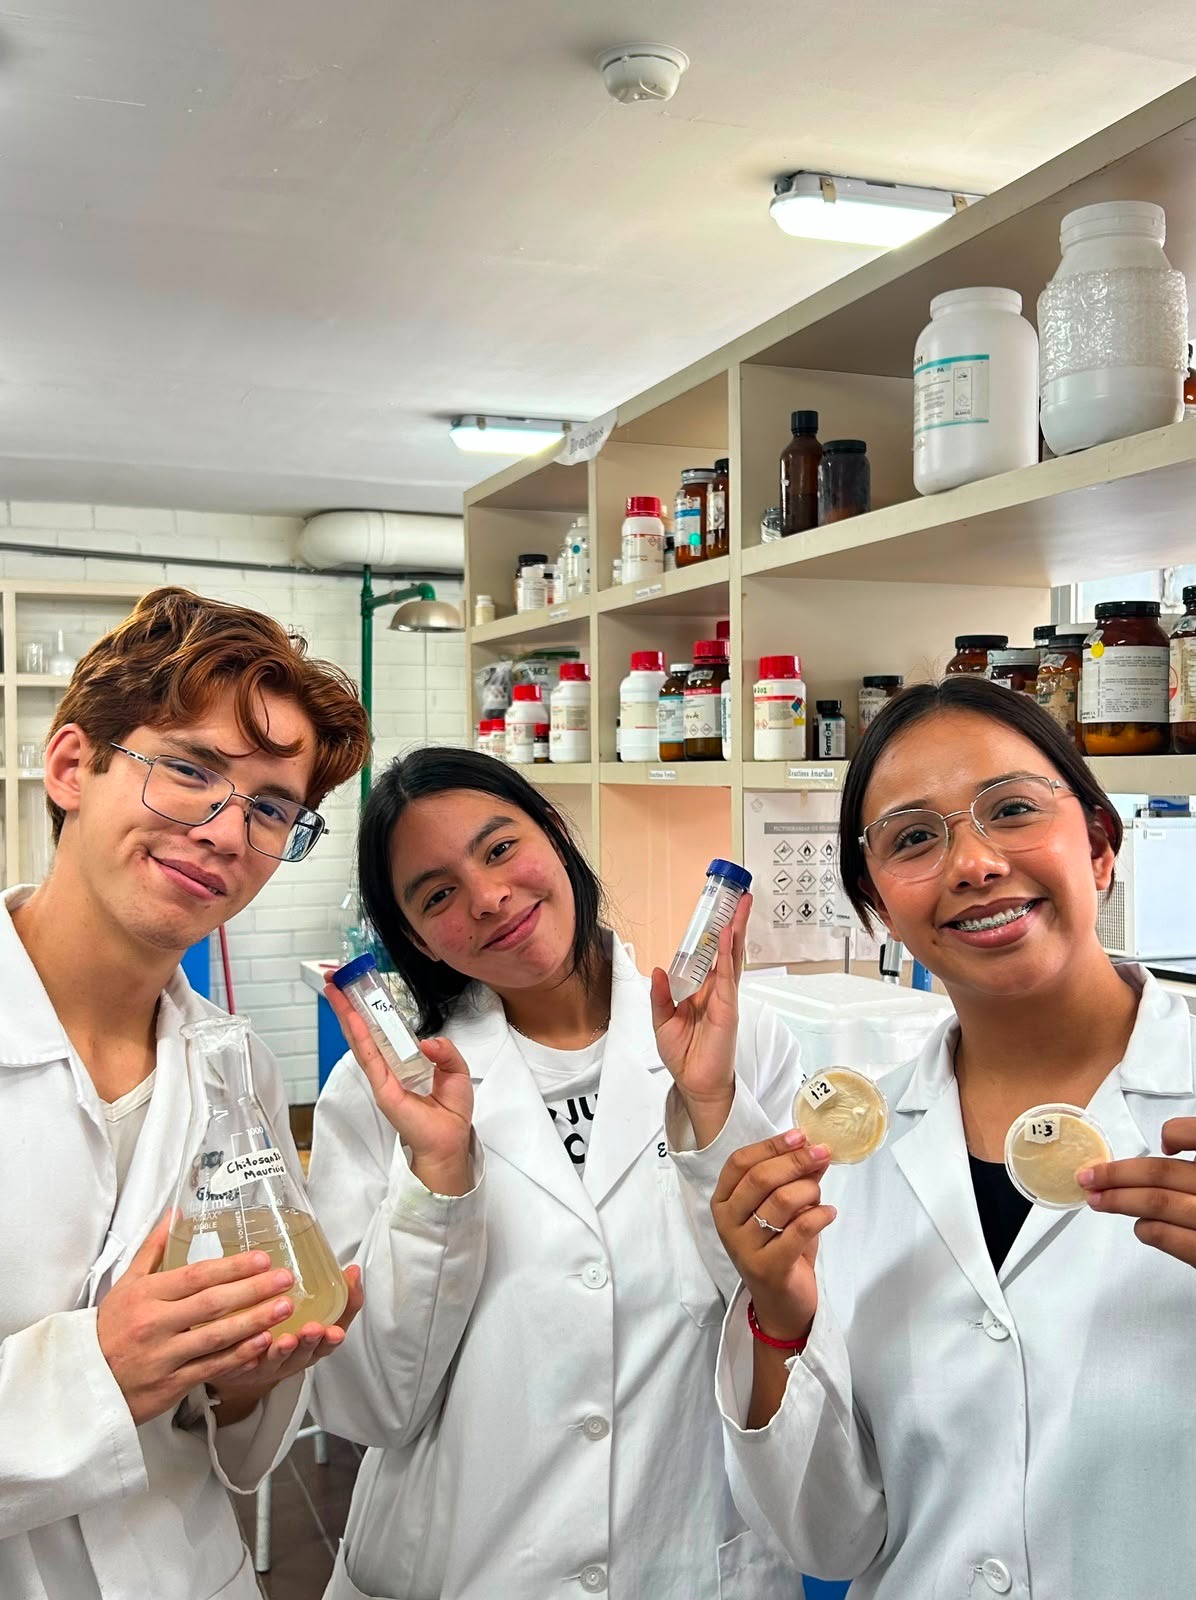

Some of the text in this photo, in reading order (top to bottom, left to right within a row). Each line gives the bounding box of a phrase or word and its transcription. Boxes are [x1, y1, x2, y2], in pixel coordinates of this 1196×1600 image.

[824, 722, 832, 756] Fermont
[811, 1082, 831, 1100] 1:2
[245, 1127, 264, 1136] 1000
[1032, 1123, 1053, 1137] 1:3
[244, 1165, 285, 1180] Mauricio
